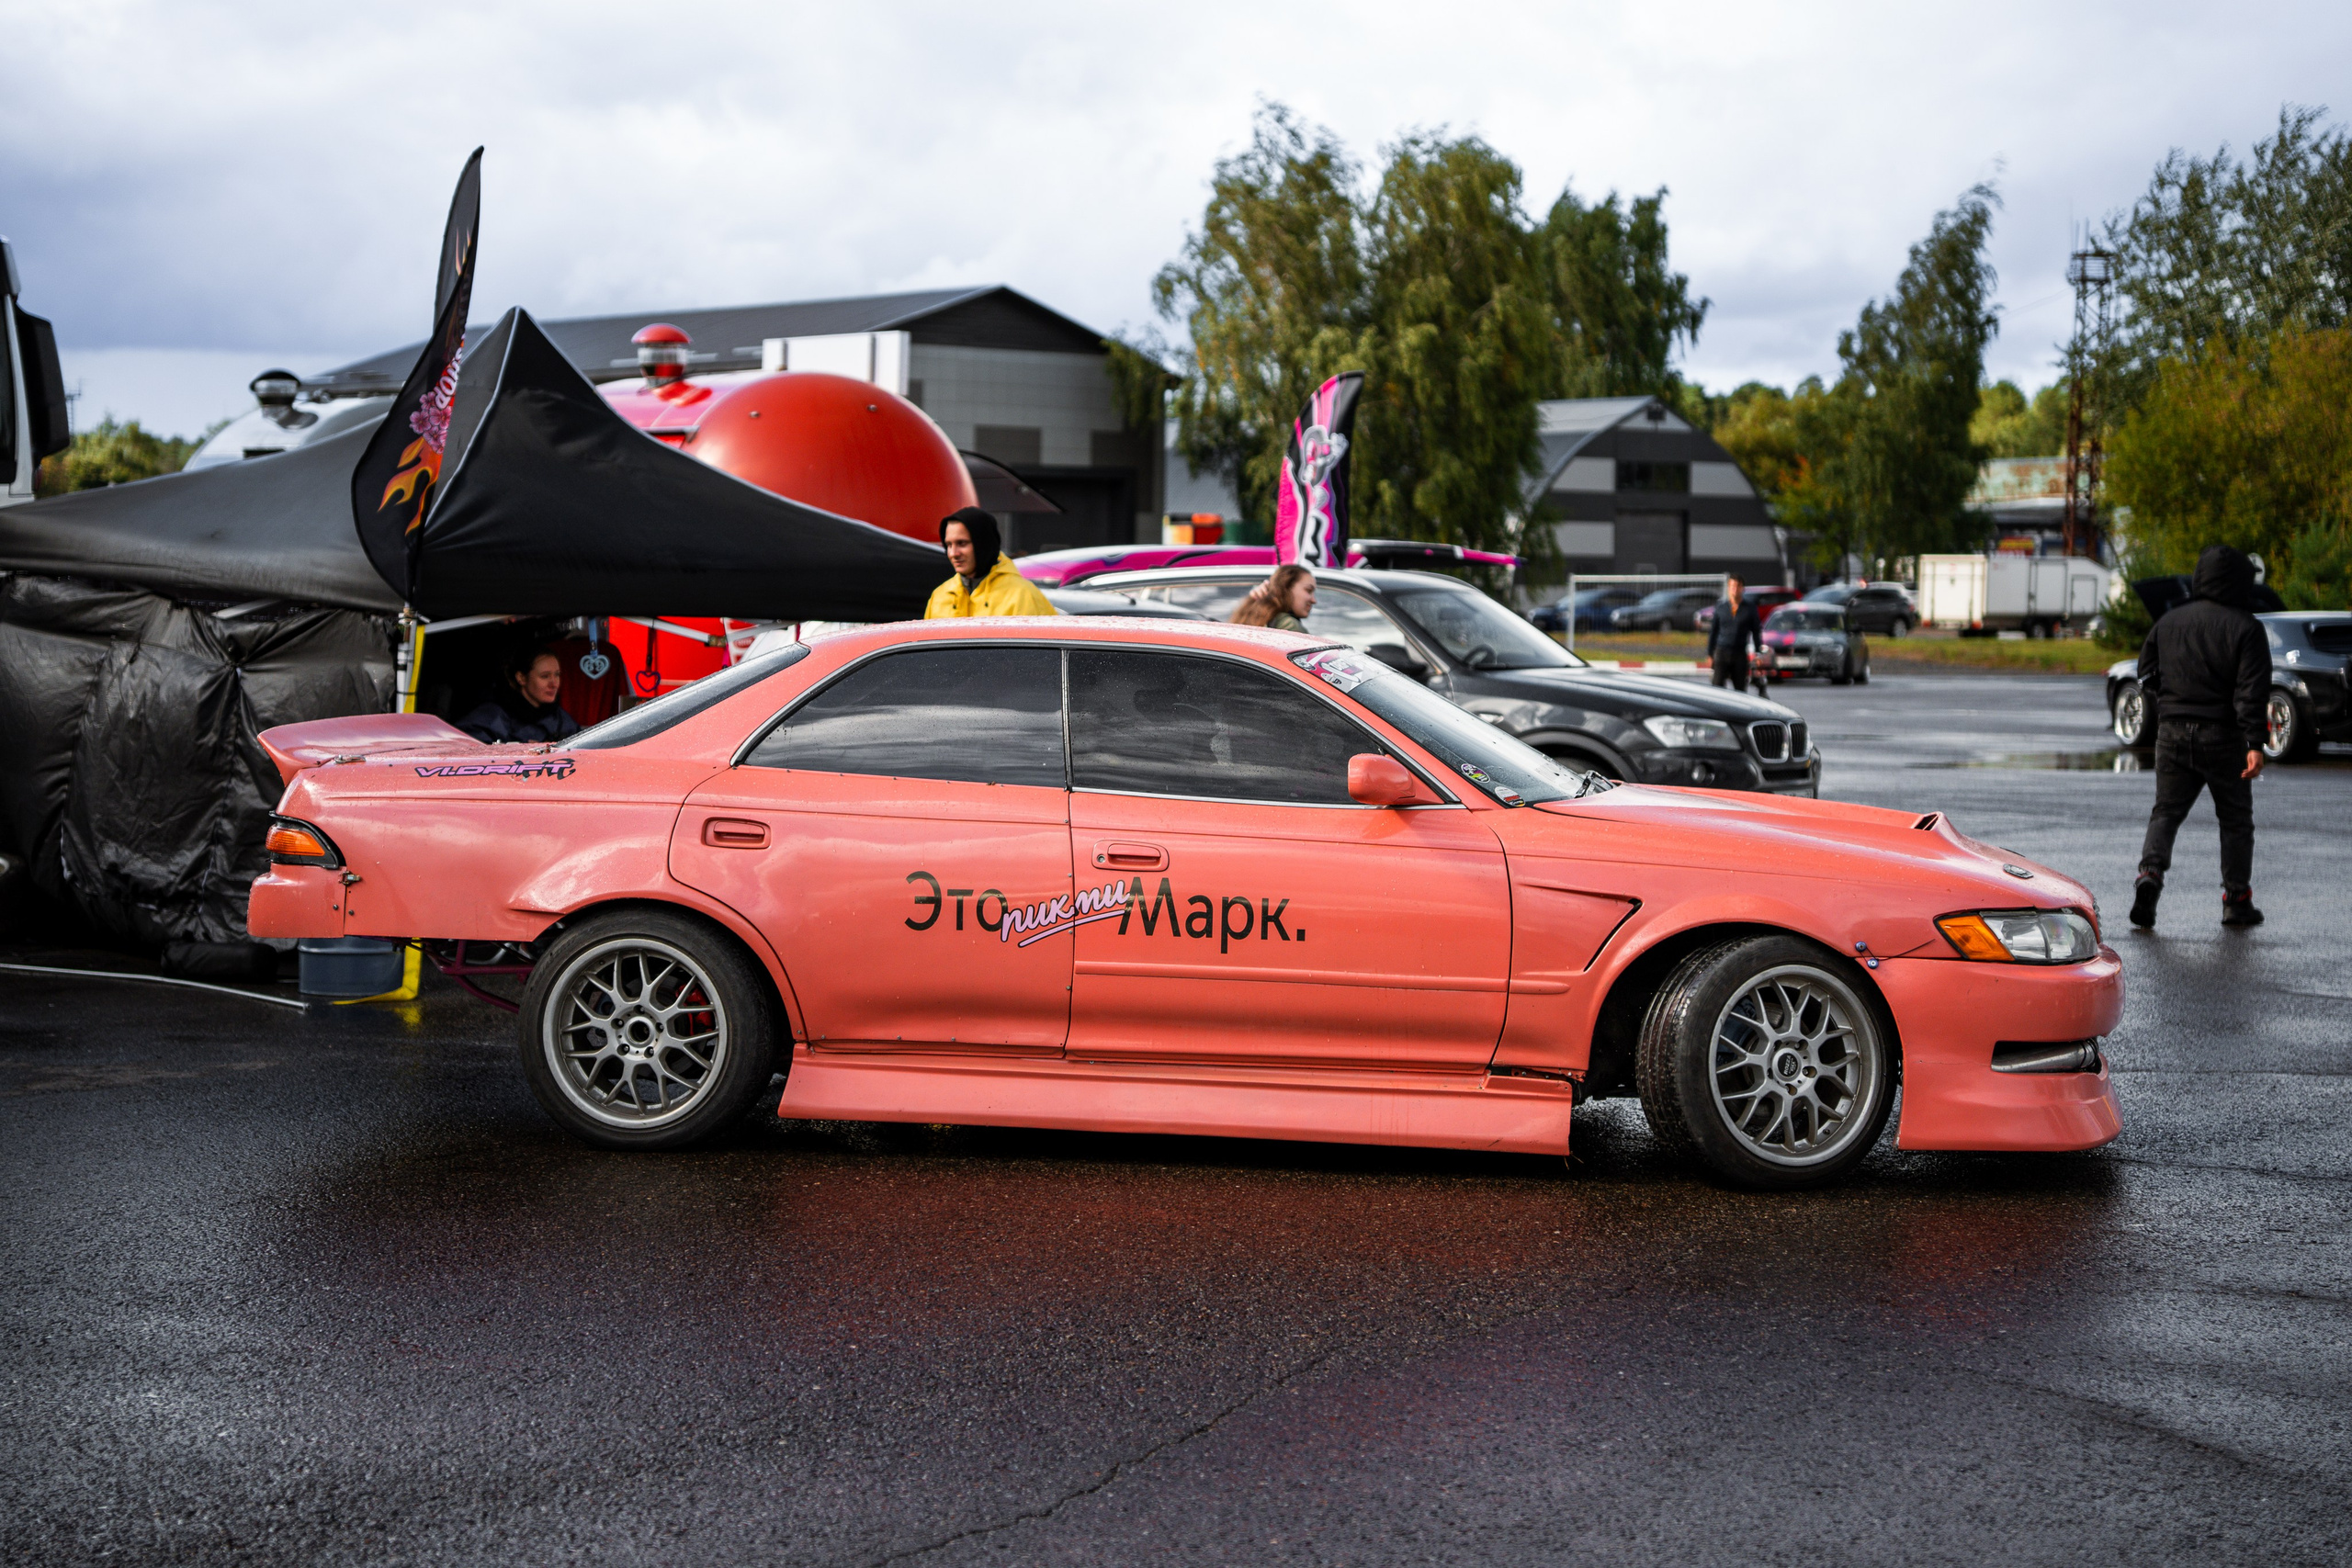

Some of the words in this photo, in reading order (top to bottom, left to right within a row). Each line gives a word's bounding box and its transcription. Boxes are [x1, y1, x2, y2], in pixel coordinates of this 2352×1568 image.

[414, 762, 574, 778] VI.DRIFT
[904, 870, 1009, 931] Это
[1117, 875, 1306, 954] Марк.
